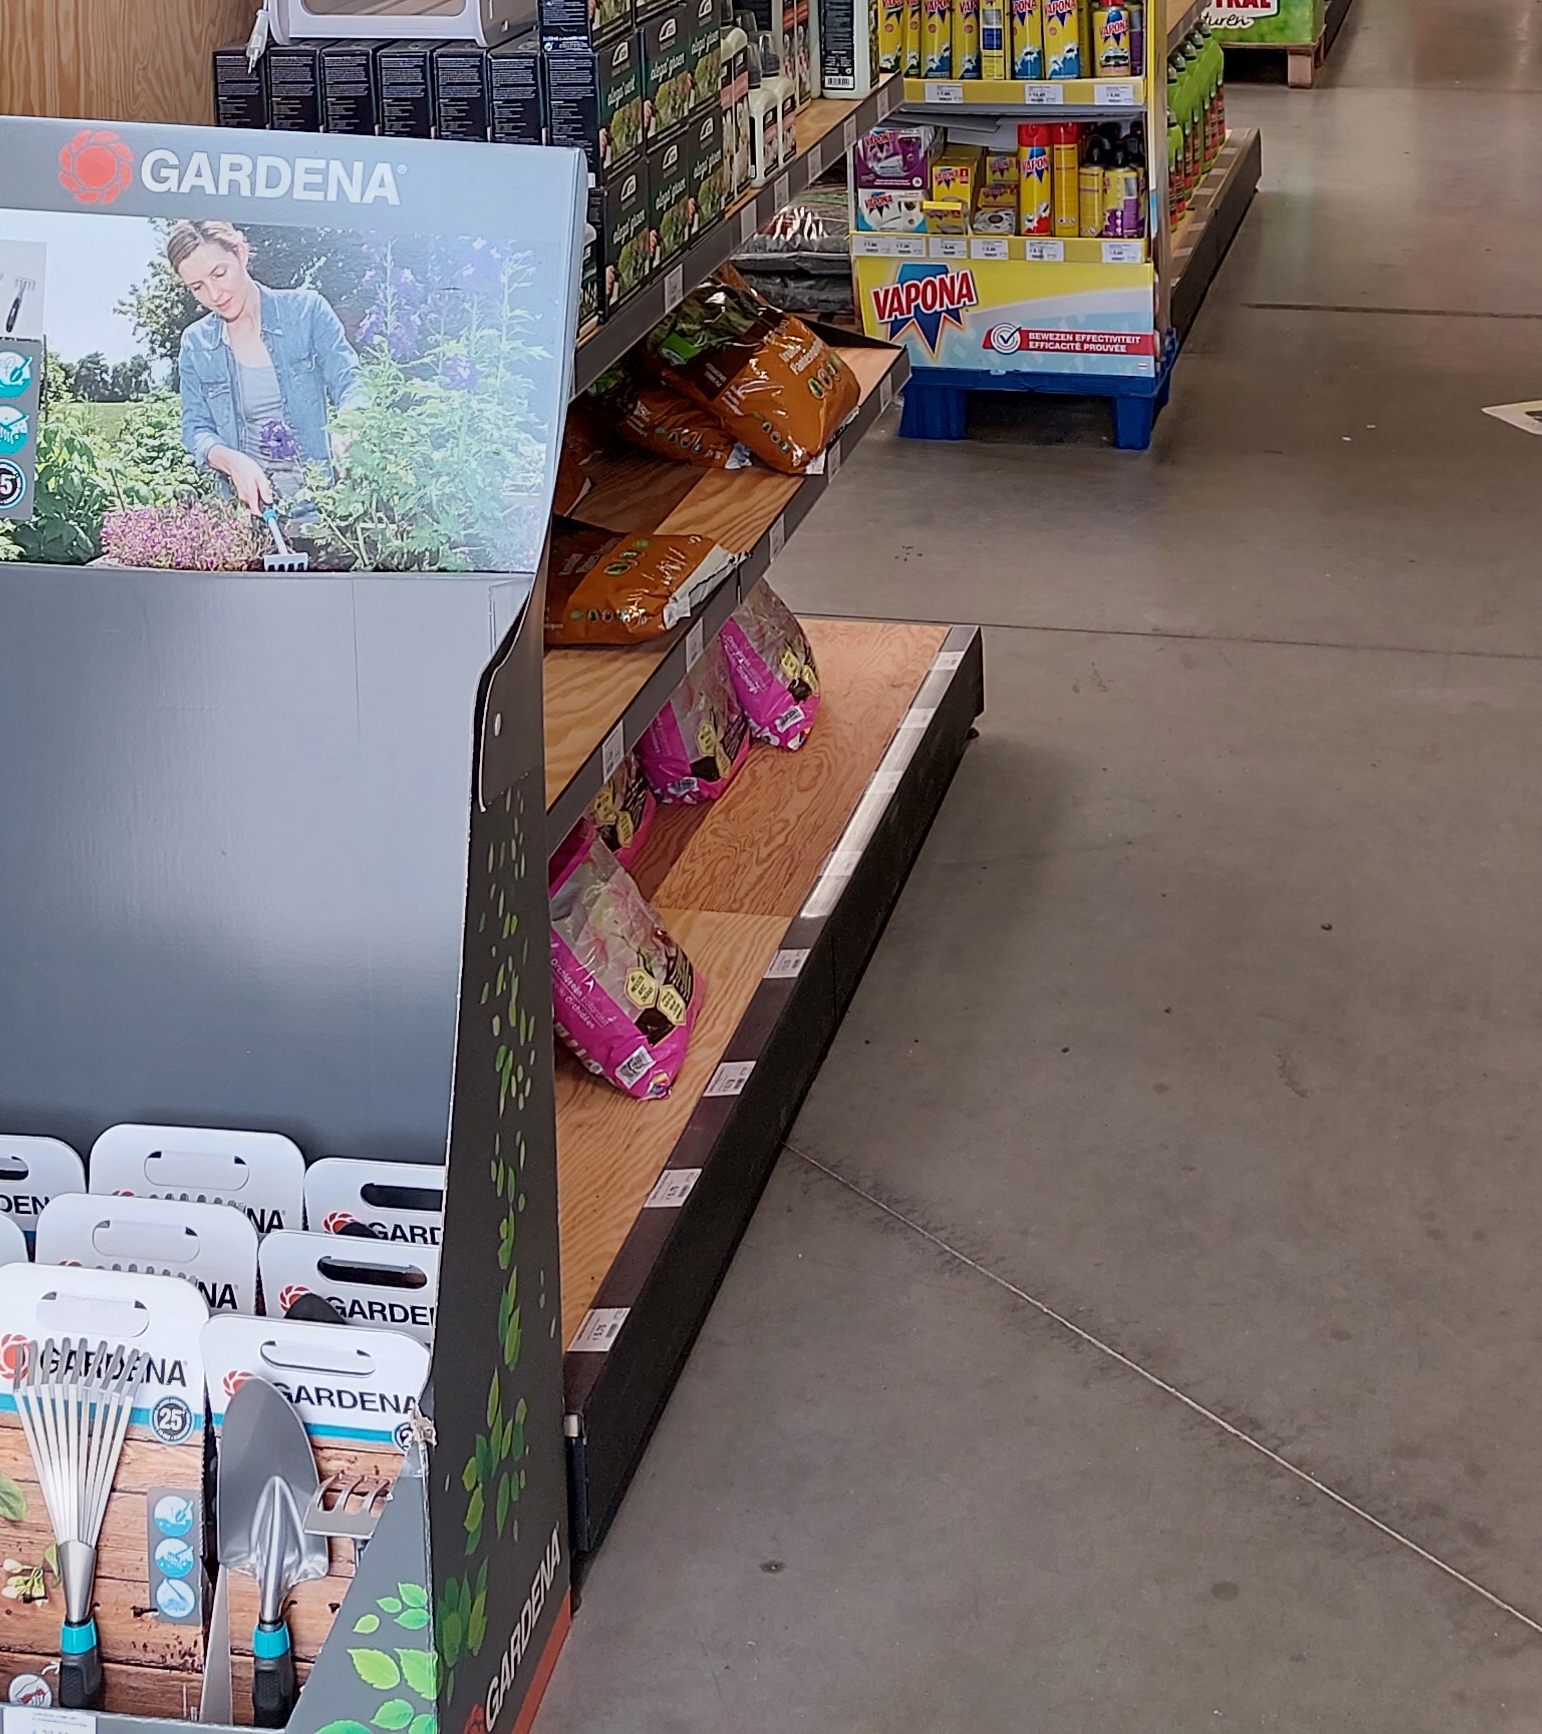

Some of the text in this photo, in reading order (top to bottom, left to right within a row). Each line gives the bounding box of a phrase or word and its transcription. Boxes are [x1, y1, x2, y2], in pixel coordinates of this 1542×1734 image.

[141, 148, 400, 206] GARDENA
[872, 270, 977, 323] VAPONA
[1029, 332, 1141, 344] BEWEZEN EFFECTIVITEIT
[1029, 342, 1127, 353] EFFICACITÉ PROUVÉE
[486, 1528, 560, 1732] GARDENA
